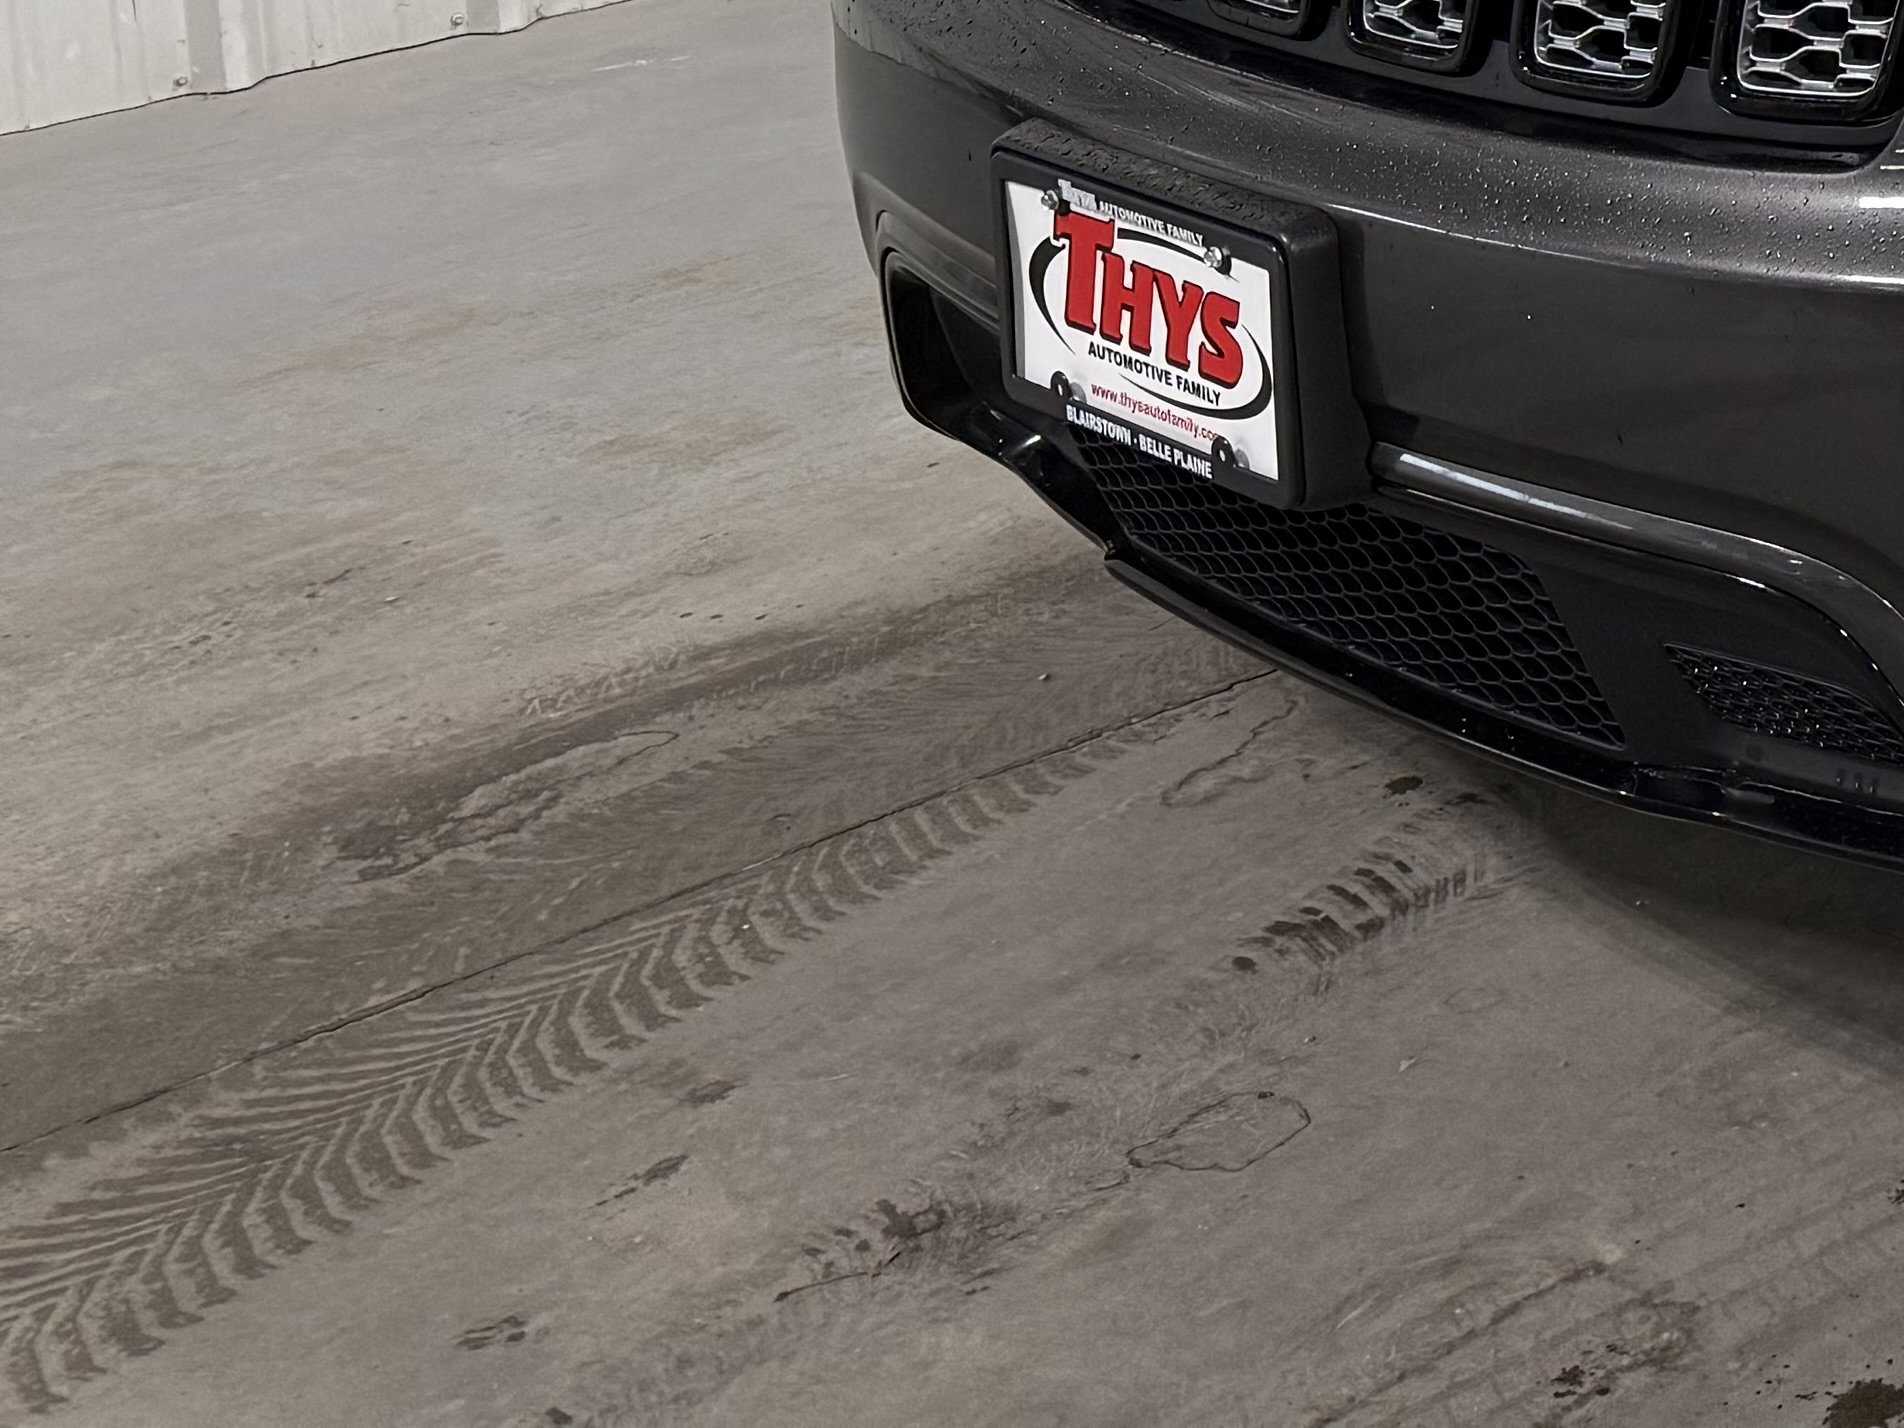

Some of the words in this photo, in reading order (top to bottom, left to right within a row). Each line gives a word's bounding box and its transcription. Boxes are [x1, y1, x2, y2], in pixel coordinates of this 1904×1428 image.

[1099, 200, 1166, 234] AUTOMOTIVE
[1166, 223, 1204, 248] FAMILY
[1053, 208, 1244, 390] THYS
[1087, 341, 1174, 387] AUTOMOTIVE
[1176, 374, 1222, 407] FAMILY
[1065, 404, 1133, 447] BLAIRSTOWN
[1138, 433, 1173, 463] BELLE
[1173, 448, 1214, 480] PLAINE
[1090, 382, 1218, 443] www.thysautofamily.co
